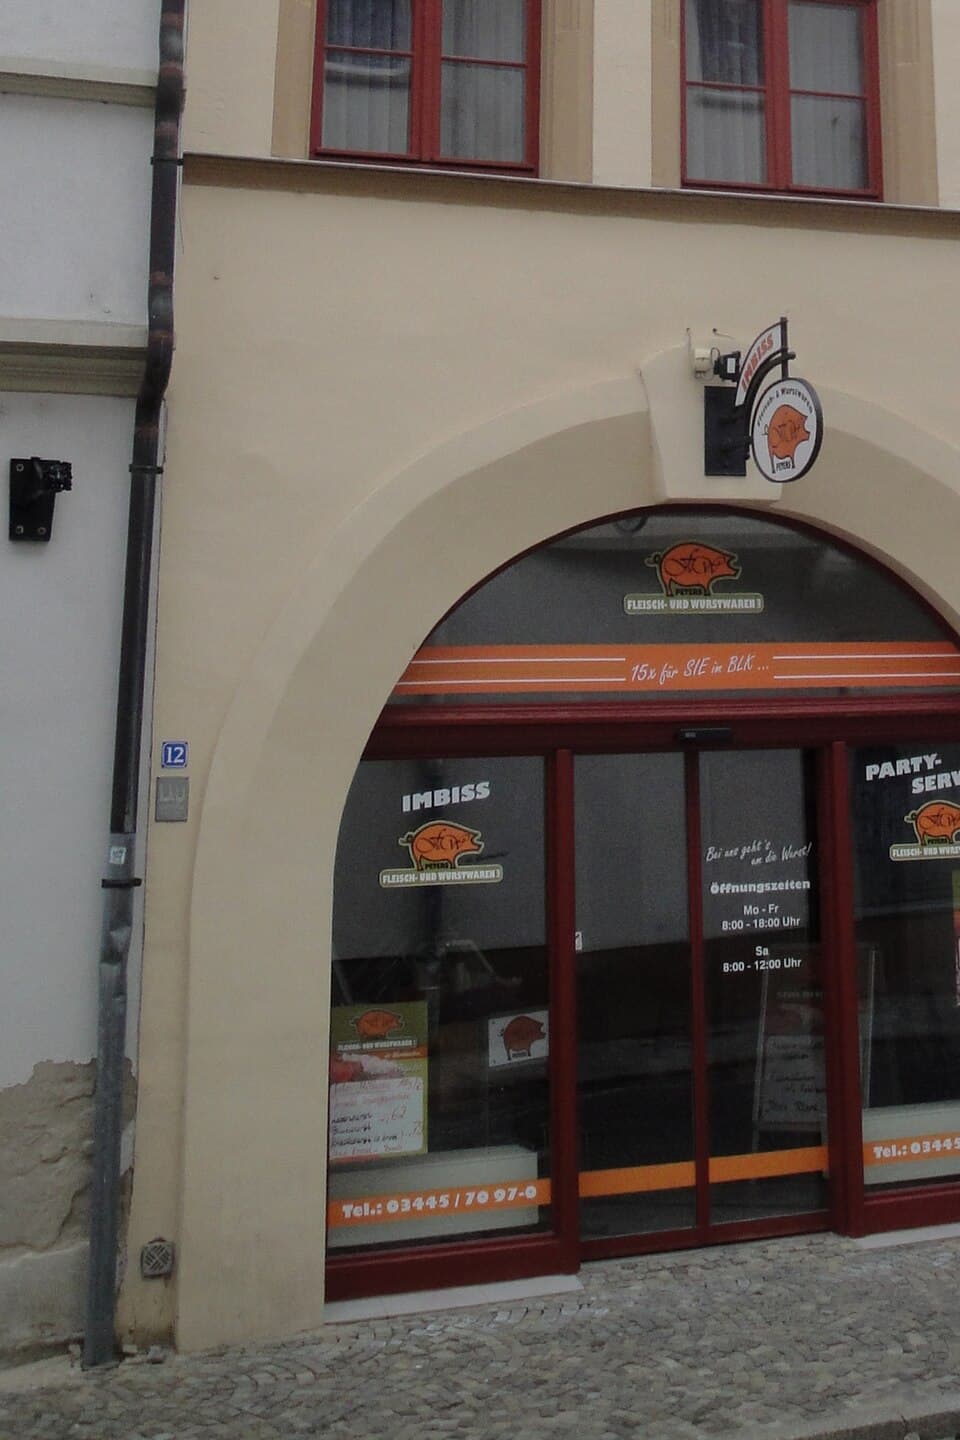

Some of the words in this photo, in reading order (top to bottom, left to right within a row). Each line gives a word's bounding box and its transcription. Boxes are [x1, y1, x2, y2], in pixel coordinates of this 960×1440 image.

[741, 333, 774, 392] IMBISS
[627, 600, 667, 610] FLEISCH-
[669, 599, 689, 609] UND
[631, 663, 657, 682] 15x
[659, 663, 678, 685] für
[683, 656, 711, 677] SIE
[727, 655, 755, 672] BLK
[166, 746, 185, 764] 12
[865, 752, 942, 781] PARTY-
[402, 781, 490, 813] IMBISS
[706, 846, 721, 862] Bei
[382, 874, 418, 884] FLEISCH-
[420, 872, 437, 881] UND
[710, 880, 811, 894] Öffnungszeiten
[743, 905, 760, 915] Mo
[768, 904, 779, 914] Fr
[722, 920, 744, 930] 8:00
[753, 918, 780, 928] 18:00
[782, 916, 800, 927] Uhr
[755, 946, 769, 956] Sa
[723, 962, 745, 972] 8:00
[754, 959, 781, 970] 12:00
[783, 958, 802, 968] Uhr
[873, 1144, 907, 1158] Tel.:
[342, 1203, 382, 1218] Tel.:
[387, 1194, 450, 1213] 03445
[454, 1194, 460, 1208] /
[464, 1190, 489, 1206] 70
[493, 1185, 537, 1202] 97-0
